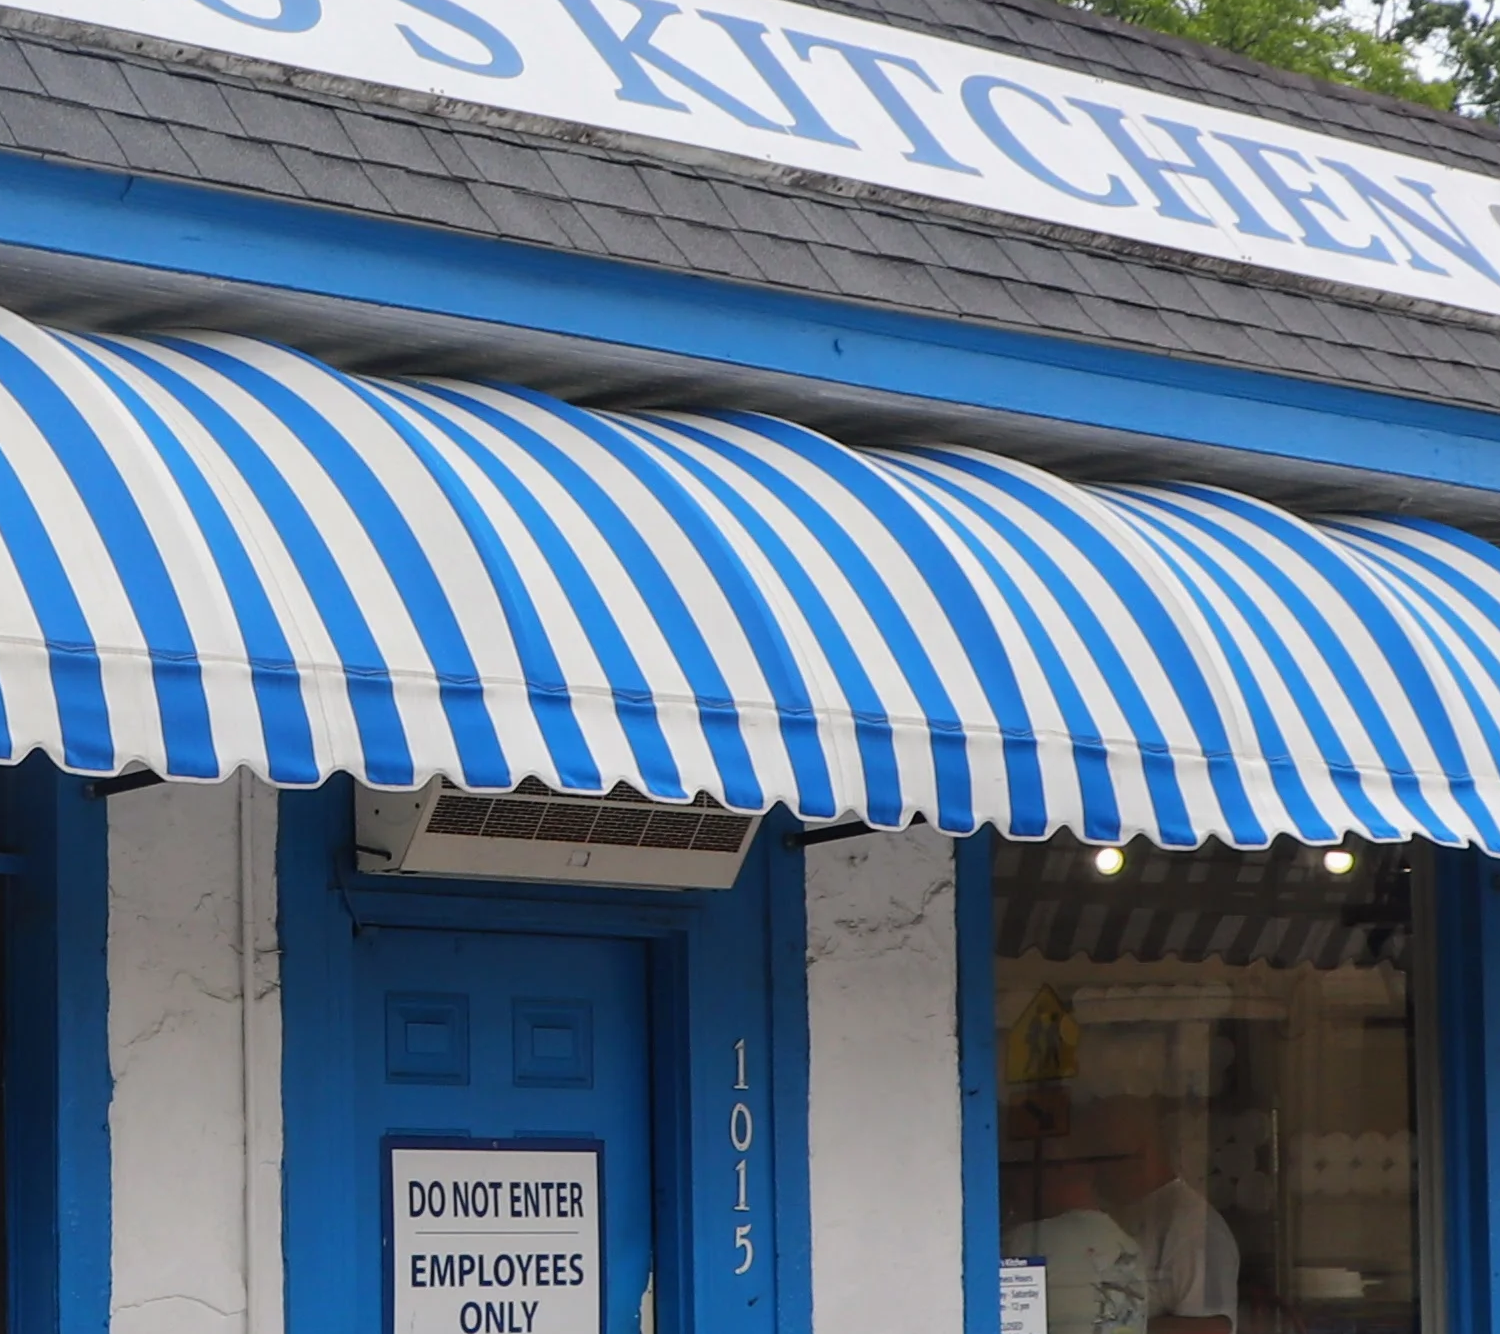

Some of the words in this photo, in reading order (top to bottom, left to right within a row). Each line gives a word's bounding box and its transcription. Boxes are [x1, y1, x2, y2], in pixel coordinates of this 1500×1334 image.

[730, 1038, 754, 1275] 1015
[408, 1180, 446, 1218] DO
[453, 1181, 502, 1218] NOT
[509, 1182, 584, 1218] ENTER
[411, 1254, 584, 1288] EMPLOYEES
[460, 1301, 539, 1334] ONLY
